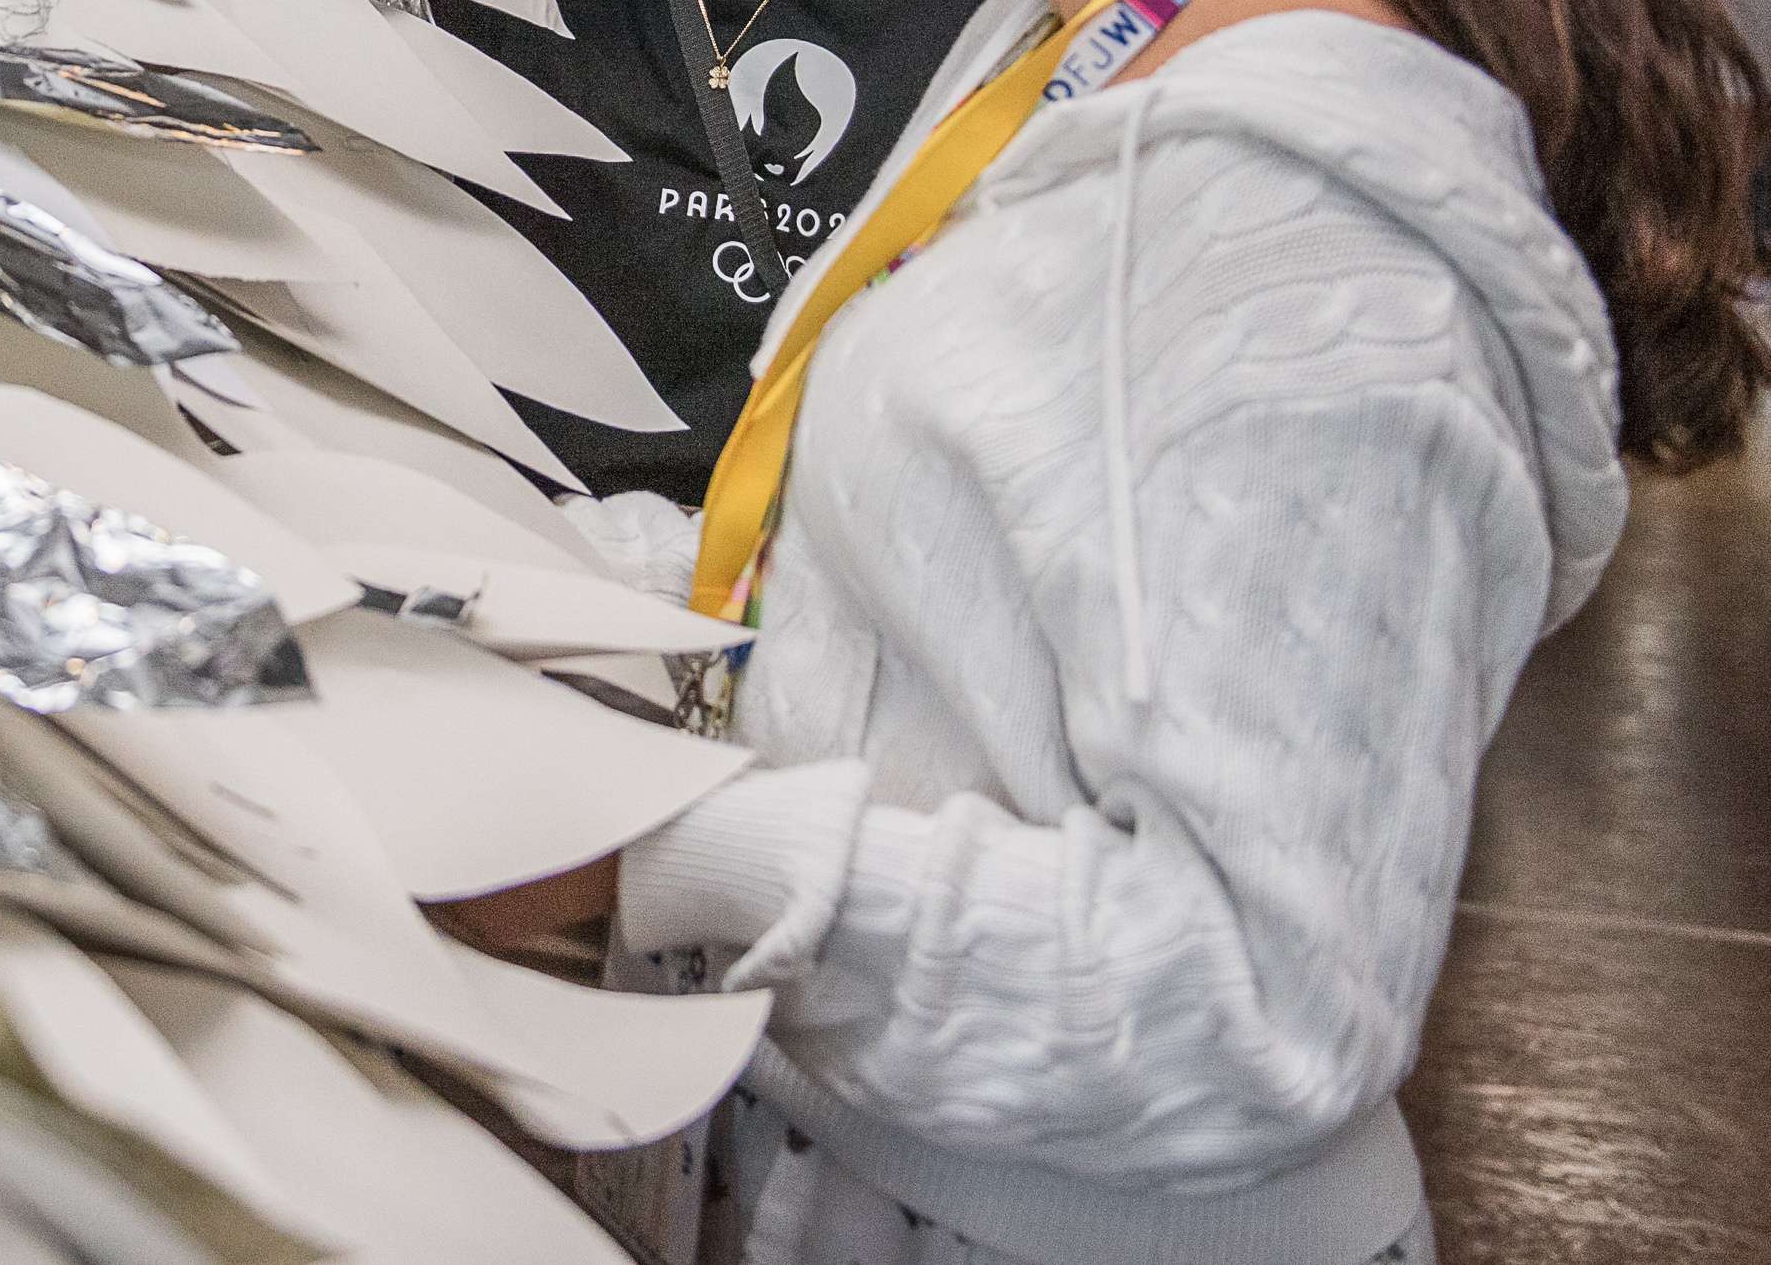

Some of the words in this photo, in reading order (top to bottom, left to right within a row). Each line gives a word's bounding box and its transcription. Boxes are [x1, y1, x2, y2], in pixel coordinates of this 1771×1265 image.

[1042, 8, 1140, 103] DFJW
[659, 188, 769, 222] PAR
[776, 202, 846, 240] 202
